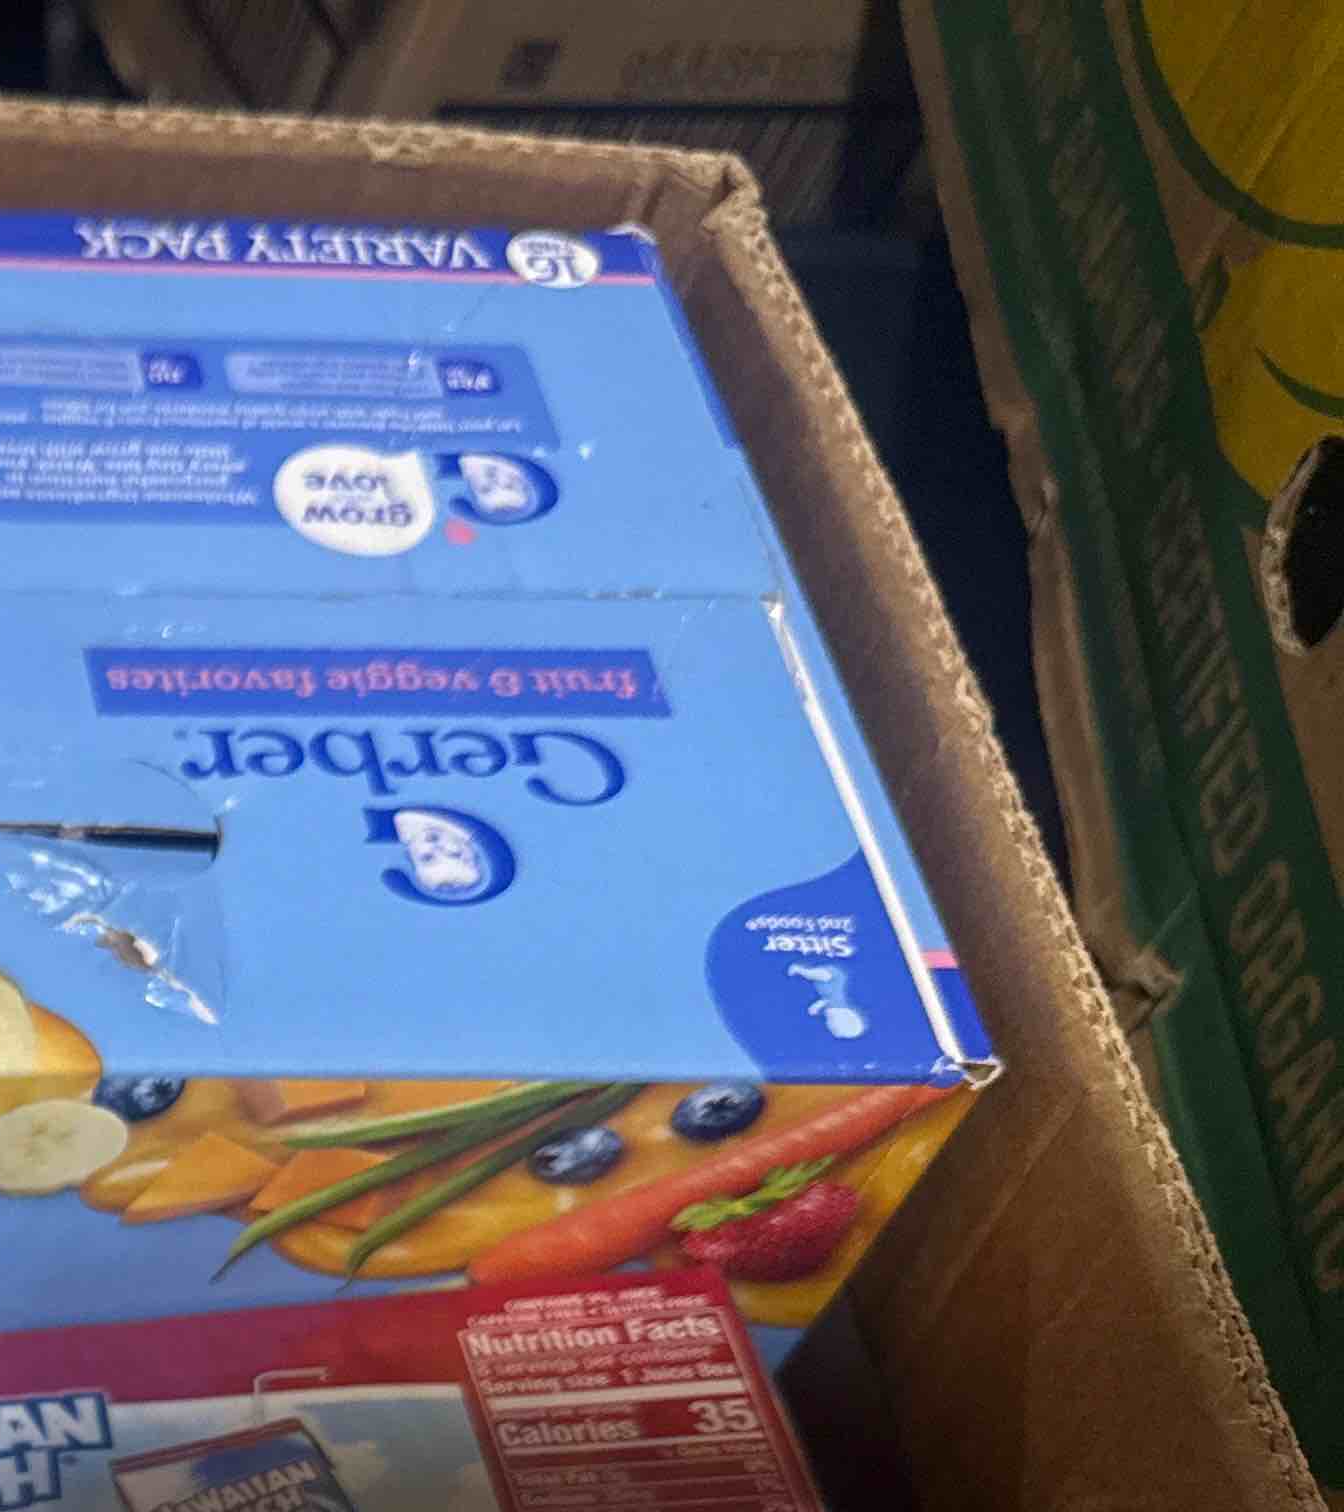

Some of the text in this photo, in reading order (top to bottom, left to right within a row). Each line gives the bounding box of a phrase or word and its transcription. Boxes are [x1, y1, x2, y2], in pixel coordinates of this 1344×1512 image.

[75, 224, 494, 271] VARIETY PACK
[301, 470, 389, 496] love
[301, 502, 412, 528] grow
[106, 666, 315, 700] favorites
[327, 659, 474, 696] veggie
[533, 667, 637, 700] fruit
[185, 727, 628, 809] Gerber
[761, 934, 854, 958] Sitter
[467, 1315, 722, 1357] Nutrition Facts
[499, 1401, 759, 1449] Calories 35
